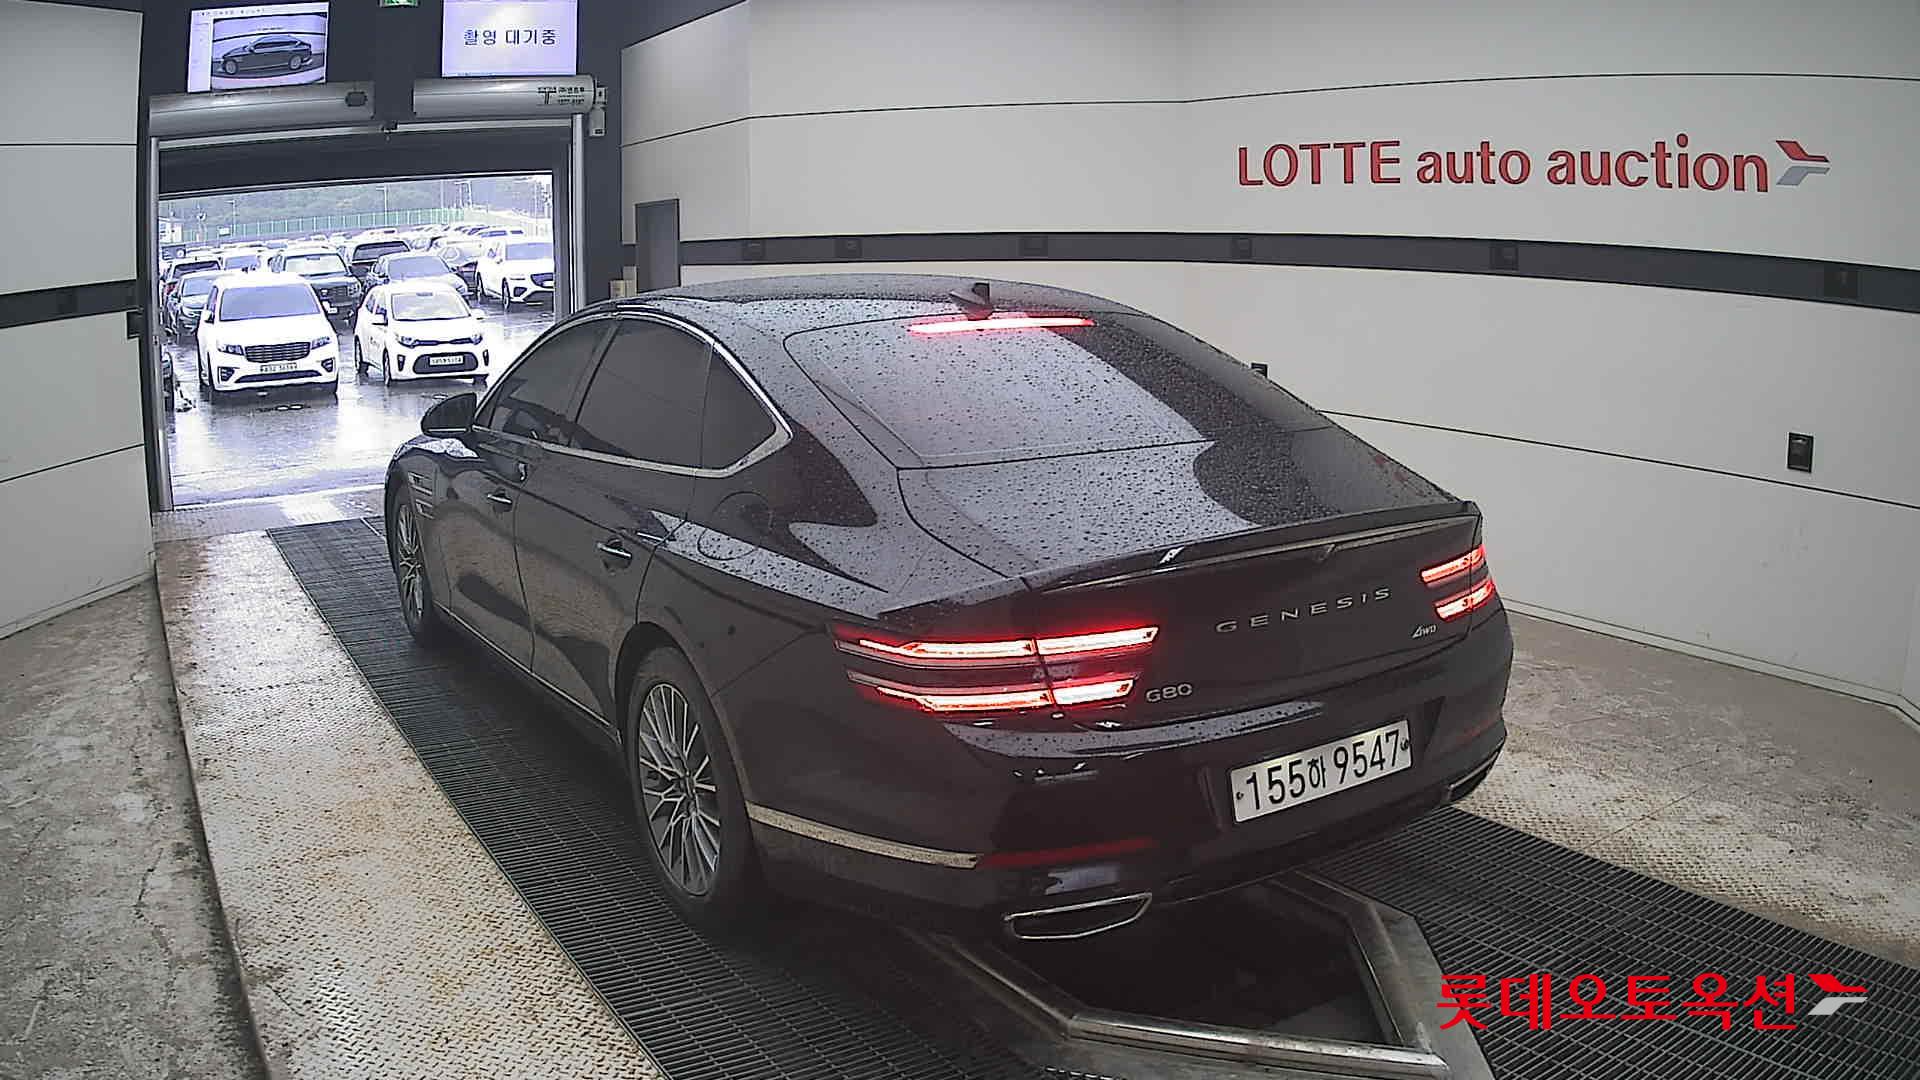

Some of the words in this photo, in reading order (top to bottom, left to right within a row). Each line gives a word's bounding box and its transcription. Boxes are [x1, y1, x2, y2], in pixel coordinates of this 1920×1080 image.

[464, 29, 497, 46] 촬영
[505, 29, 557, 46] 대기중
[1238, 140, 1401, 187] LOTTE
[1416, 141, 1531, 187] auto
[1547, 134, 1768, 193] auction
[1216, 588, 1391, 633] GENESIS
[1146, 683, 1193, 703] G80
[1247, 755, 1327, 810] 155하
[1333, 729, 1399, 785] 9547
